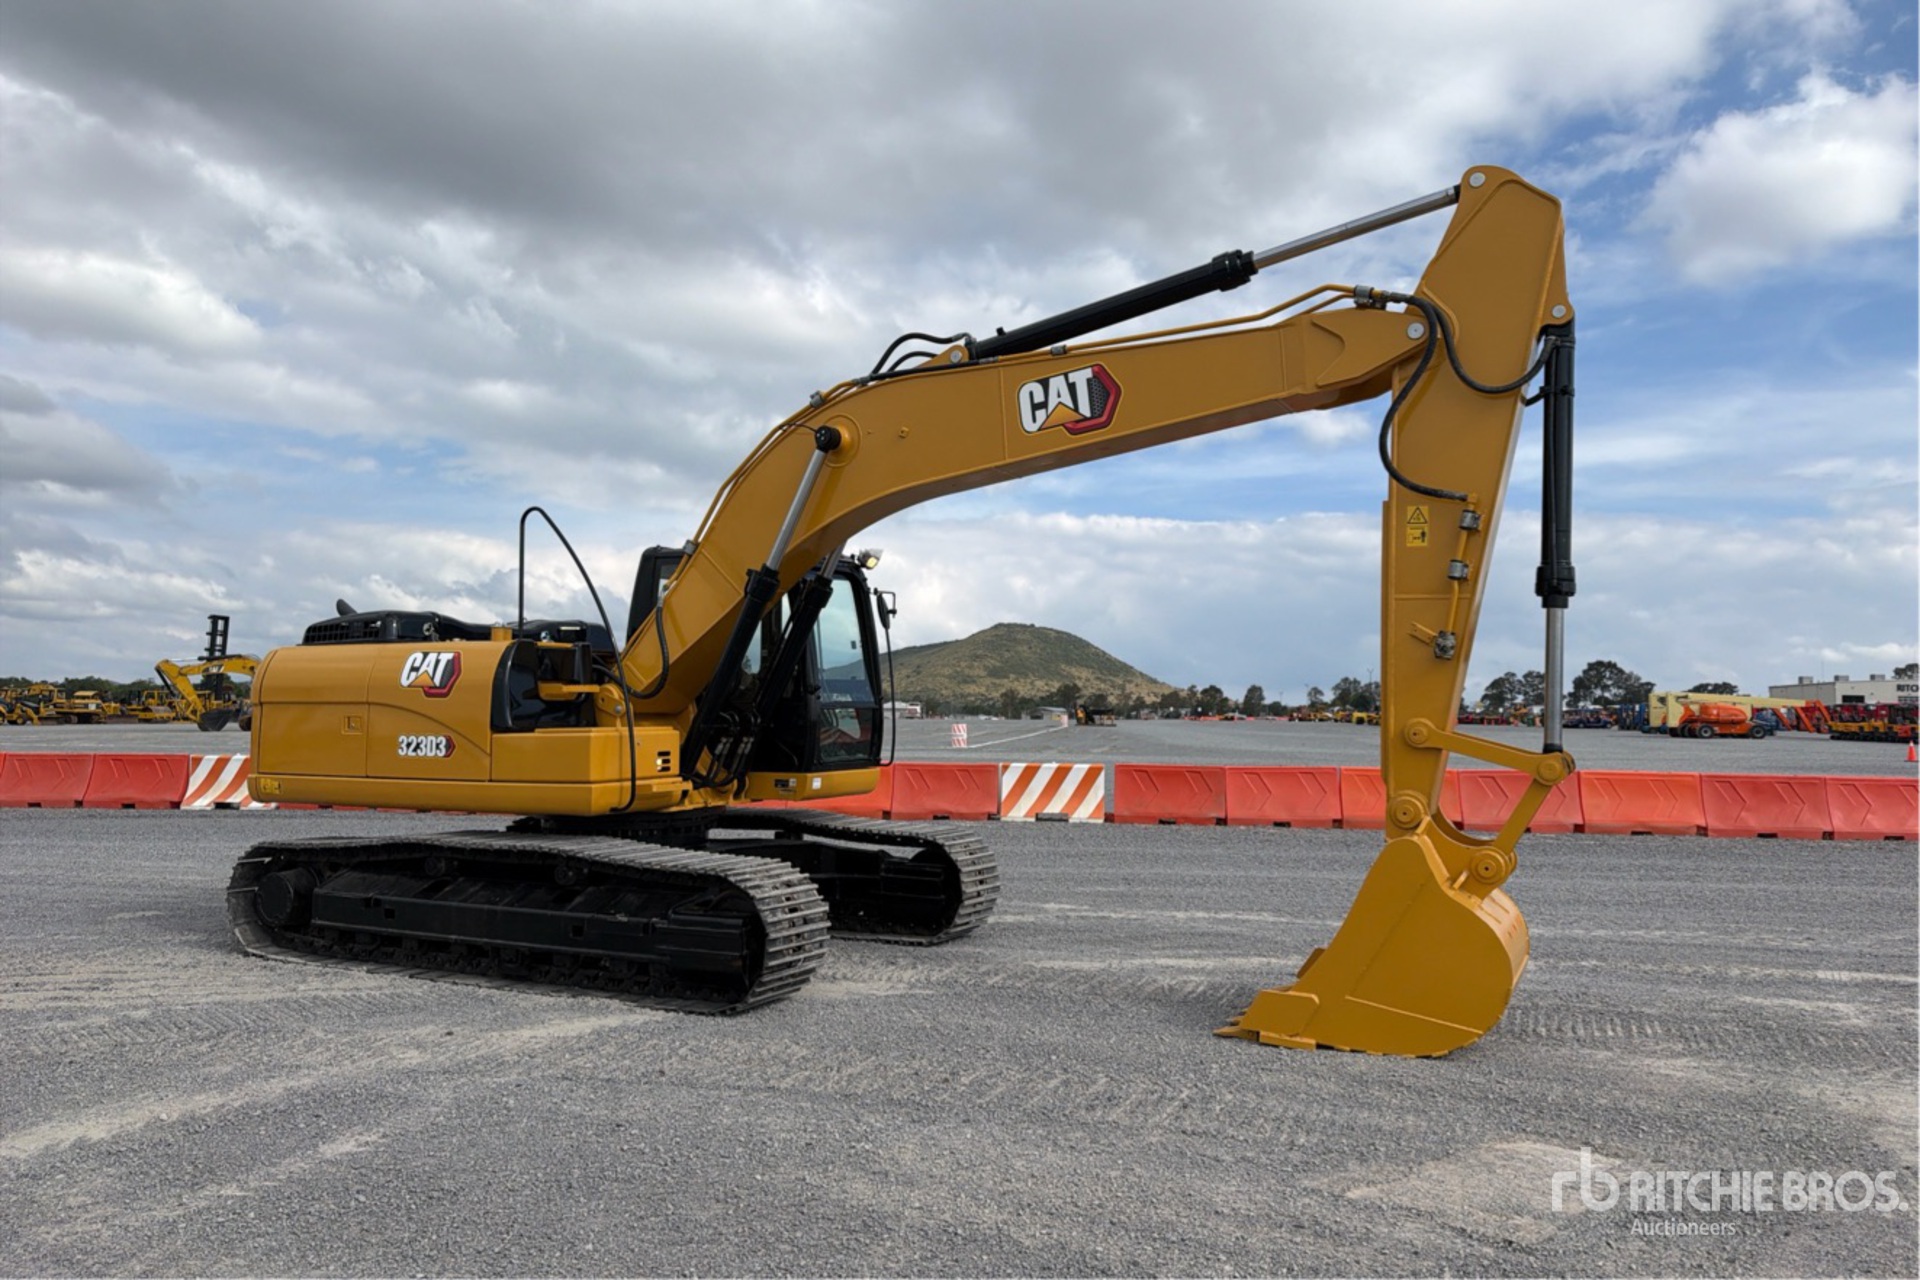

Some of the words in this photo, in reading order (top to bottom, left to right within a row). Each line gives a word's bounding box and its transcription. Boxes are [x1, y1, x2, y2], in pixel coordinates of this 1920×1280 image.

[1019, 366, 1093, 432] CAT
[400, 652, 455, 688] CAT
[398, 735, 447, 757] 323D3
